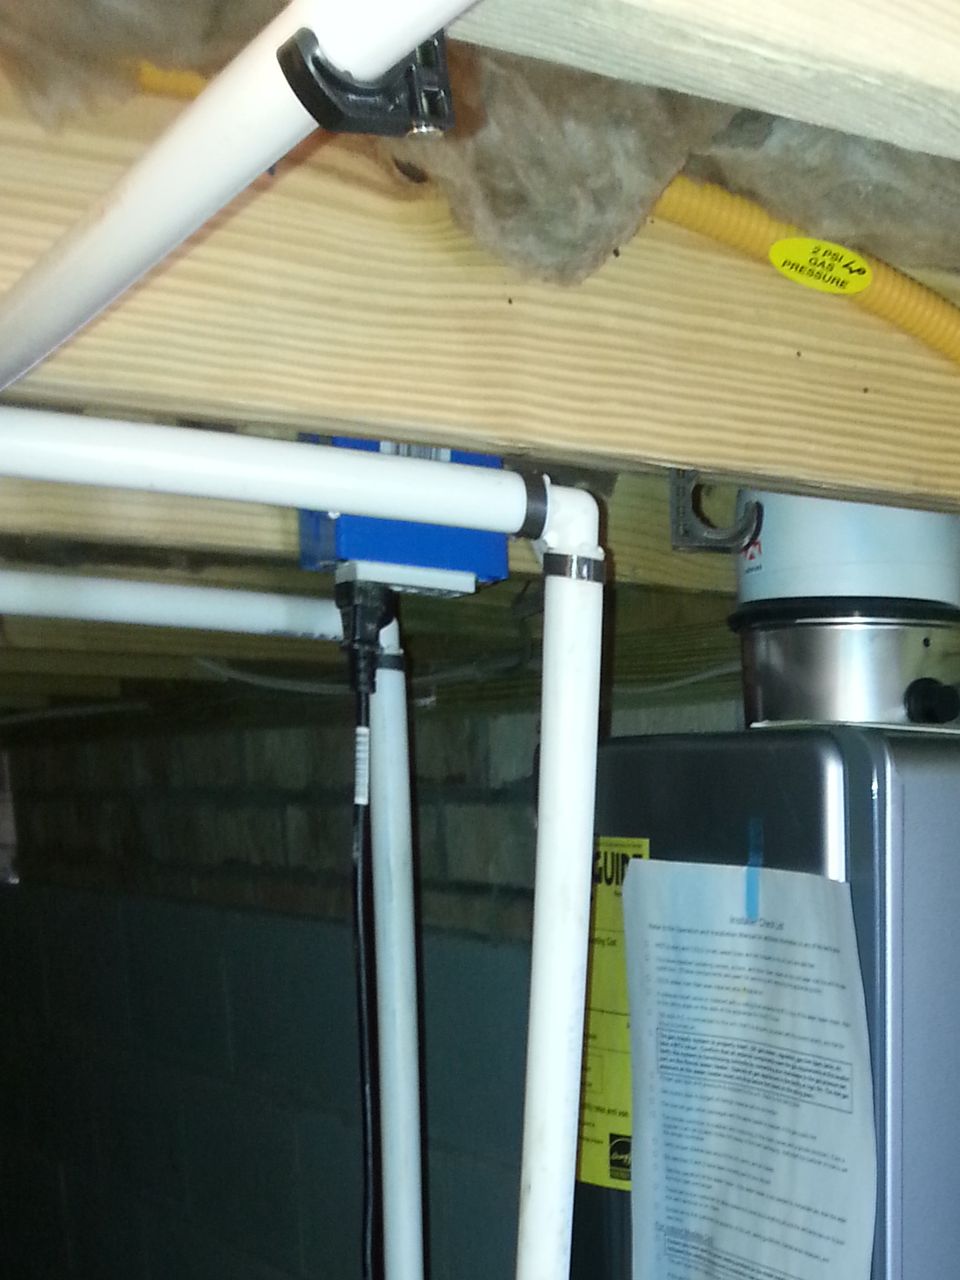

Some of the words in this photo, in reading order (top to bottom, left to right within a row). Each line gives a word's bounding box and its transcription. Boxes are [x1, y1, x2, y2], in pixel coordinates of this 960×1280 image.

[811, 245, 821, 254] 2
[822, 249, 843, 262] PSI
[809, 257, 836, 272] GAS
[782, 259, 849, 289] PRESSURE
